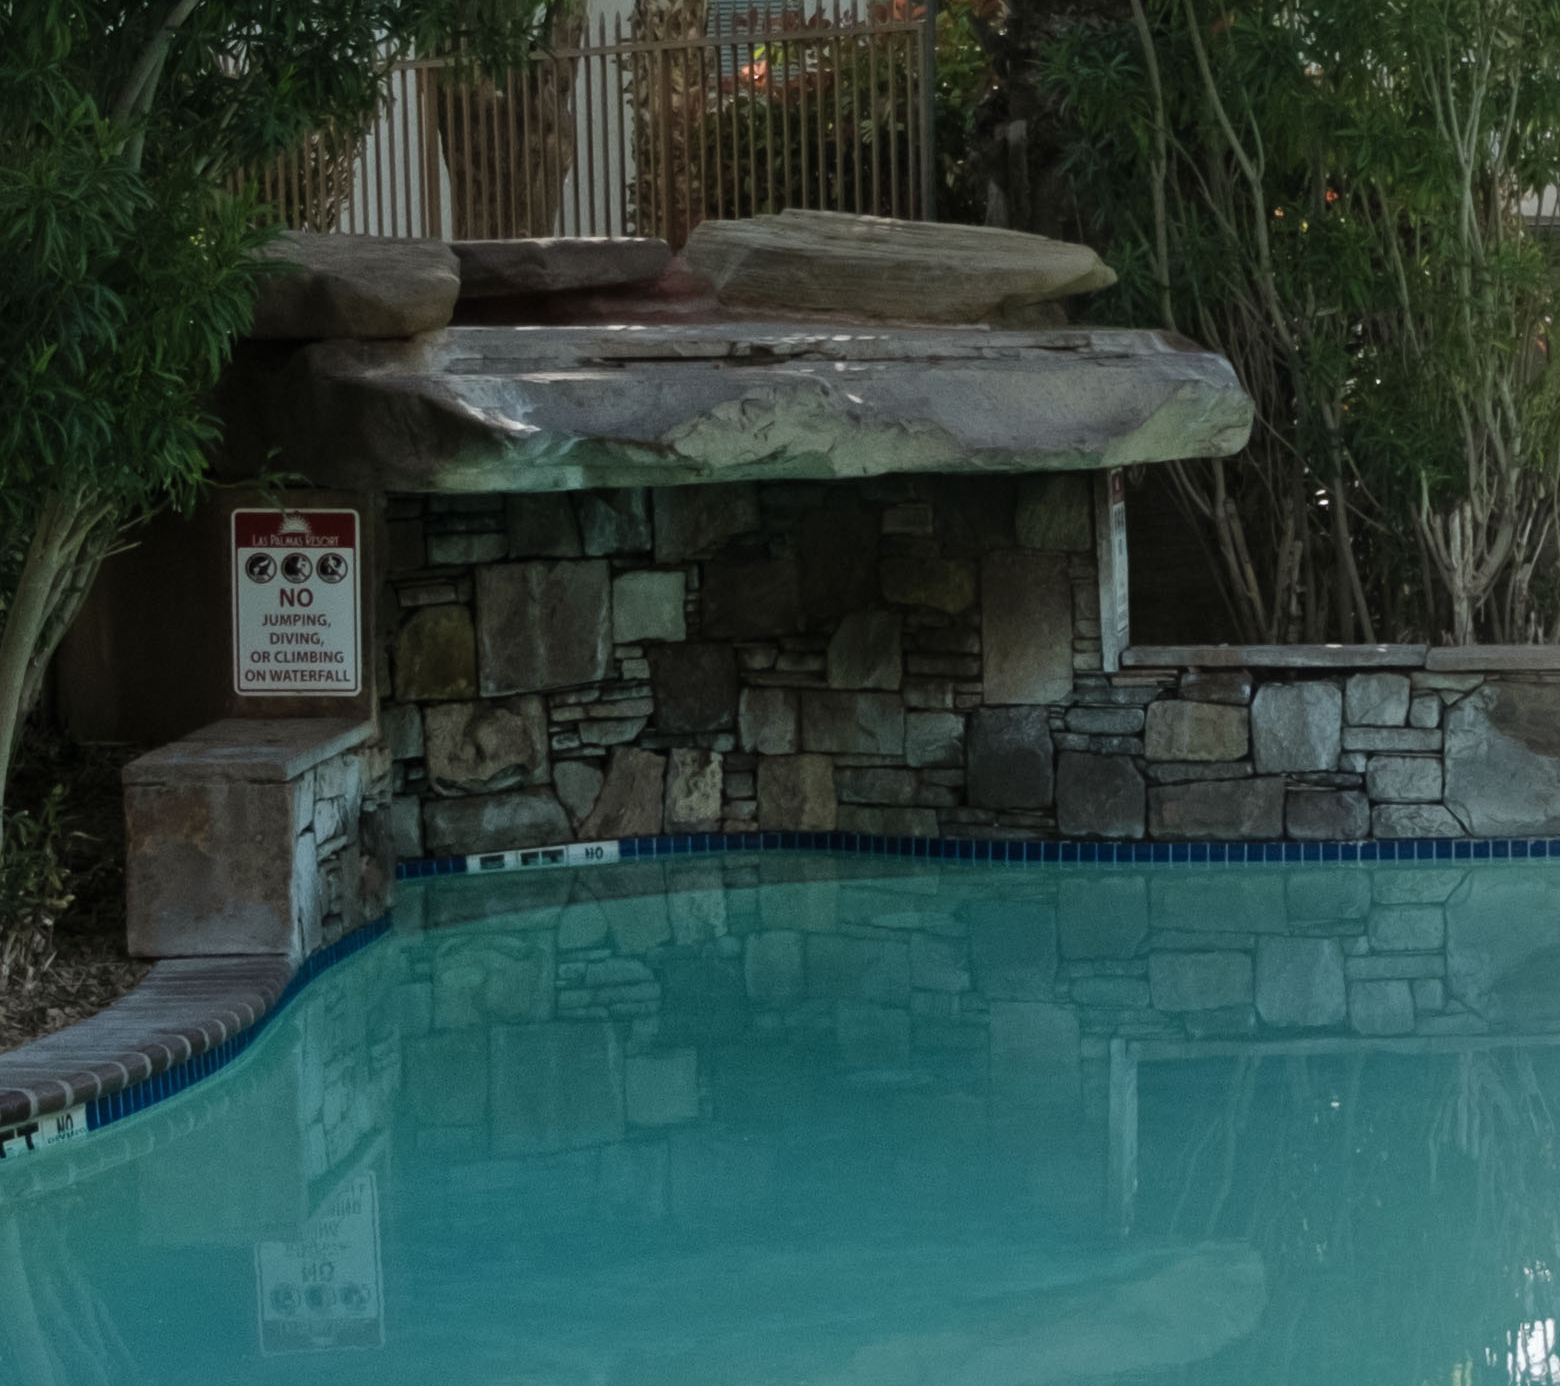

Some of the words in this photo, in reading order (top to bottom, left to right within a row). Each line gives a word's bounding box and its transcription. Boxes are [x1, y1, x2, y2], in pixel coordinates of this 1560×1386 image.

[279, 588, 314, 608] NO
[262, 613, 332, 628] JUMPING,
[270, 633, 325, 647] DIVING,
[250, 652, 270, 663] OR
[274, 651, 344, 664] CLIMBING
[245, 670, 266, 682] ON
[270, 669, 350, 683] WATERFALL
[56, 1113, 74, 1134] NO
